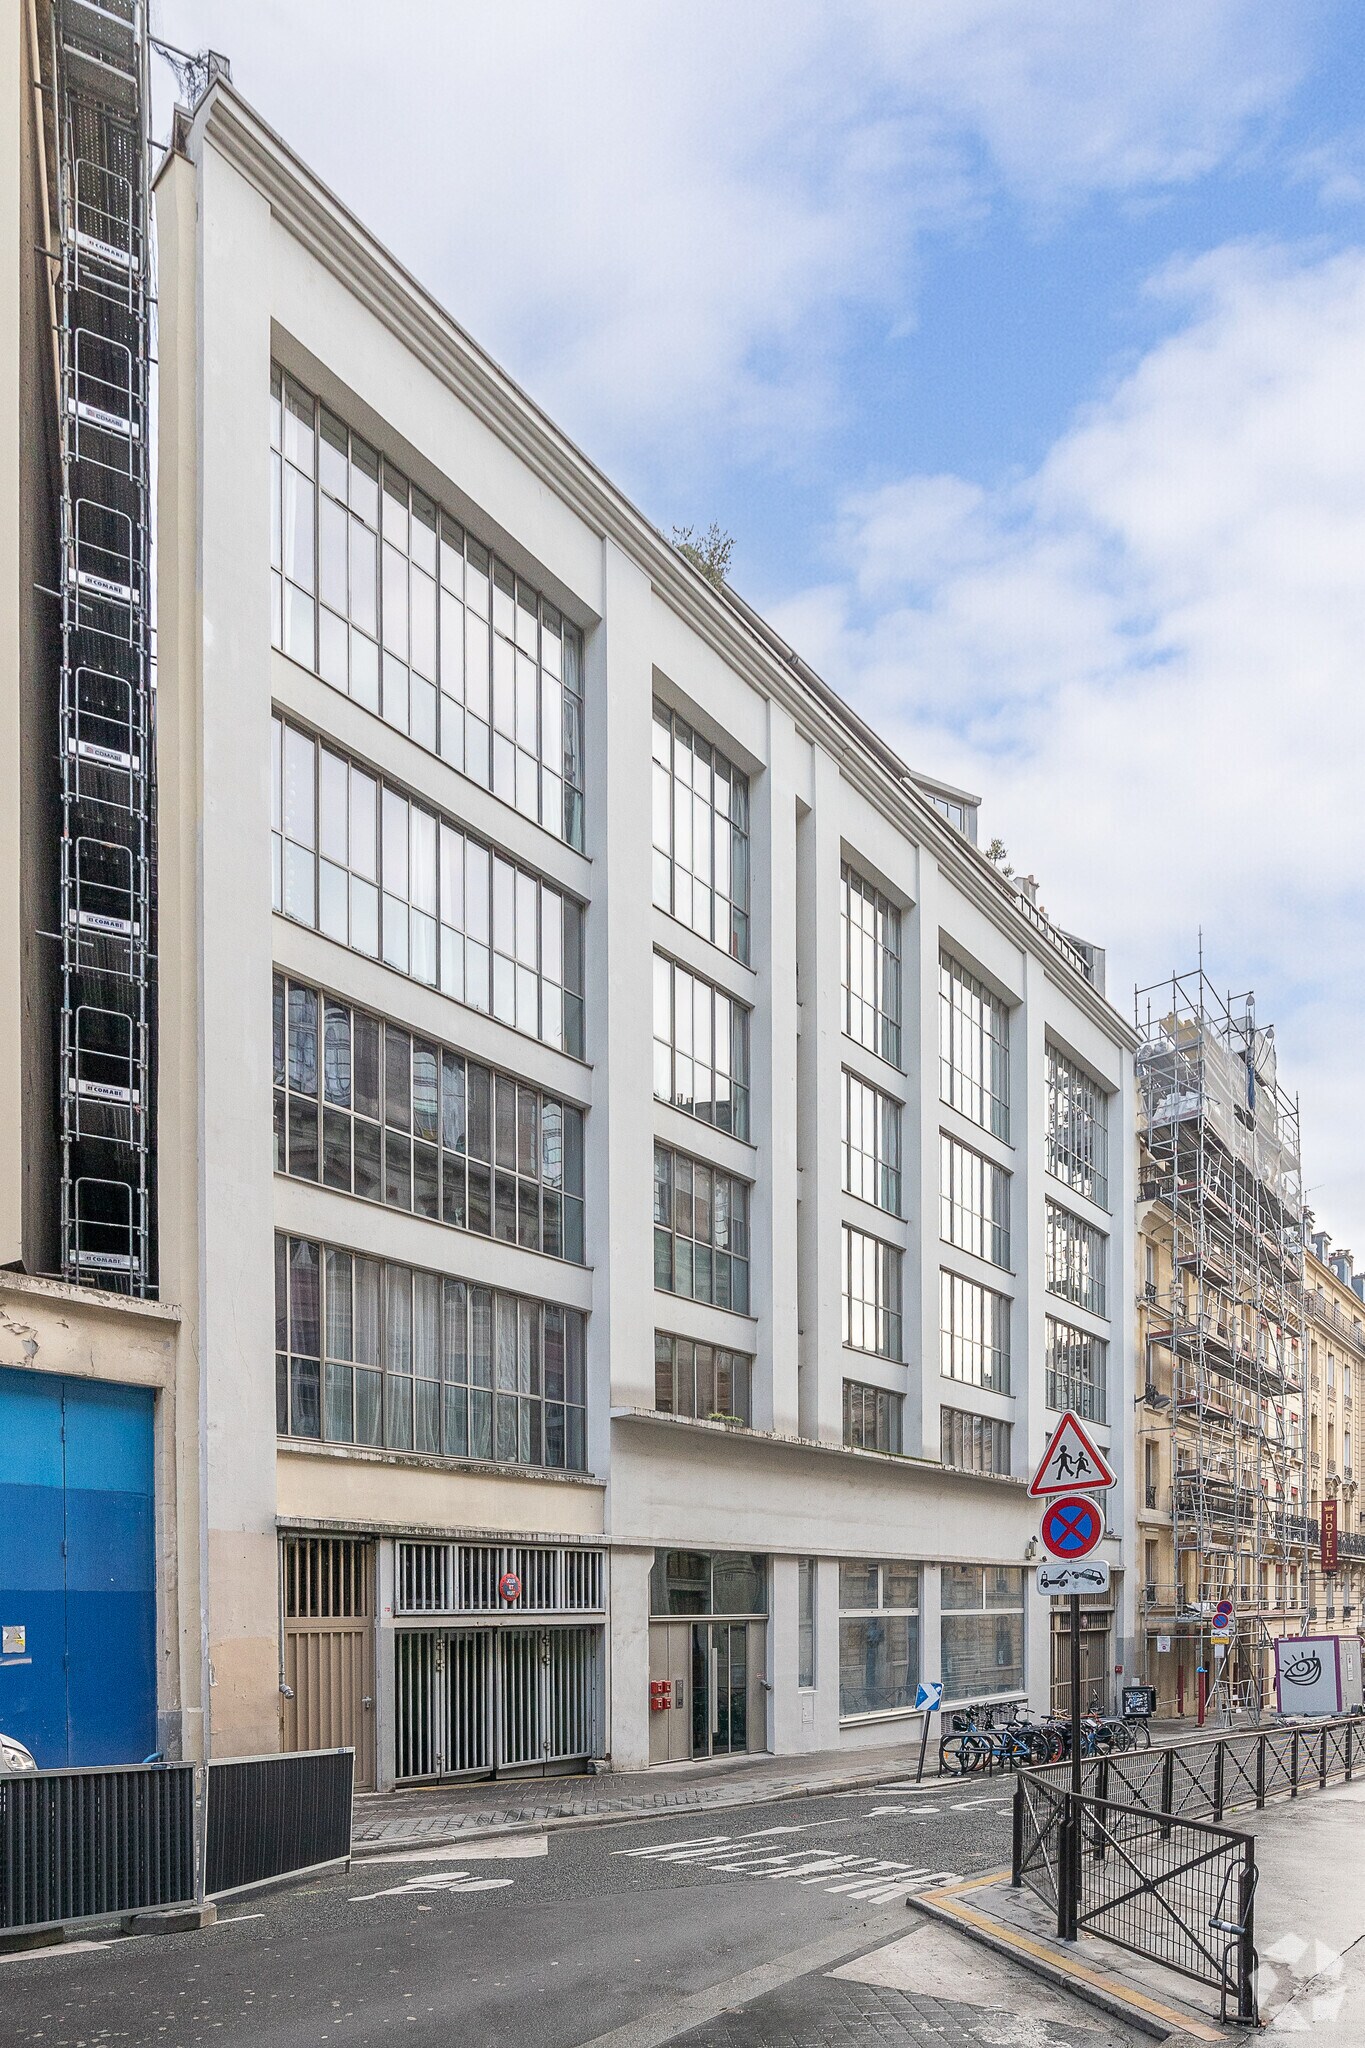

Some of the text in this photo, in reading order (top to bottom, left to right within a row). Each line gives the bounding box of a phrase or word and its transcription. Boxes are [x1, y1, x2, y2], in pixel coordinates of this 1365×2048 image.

[95, 918, 122, 928] COMABI
[95, 1086, 122, 1096] COMABI
[1325, 1513, 1333, 1557] HOTEL
